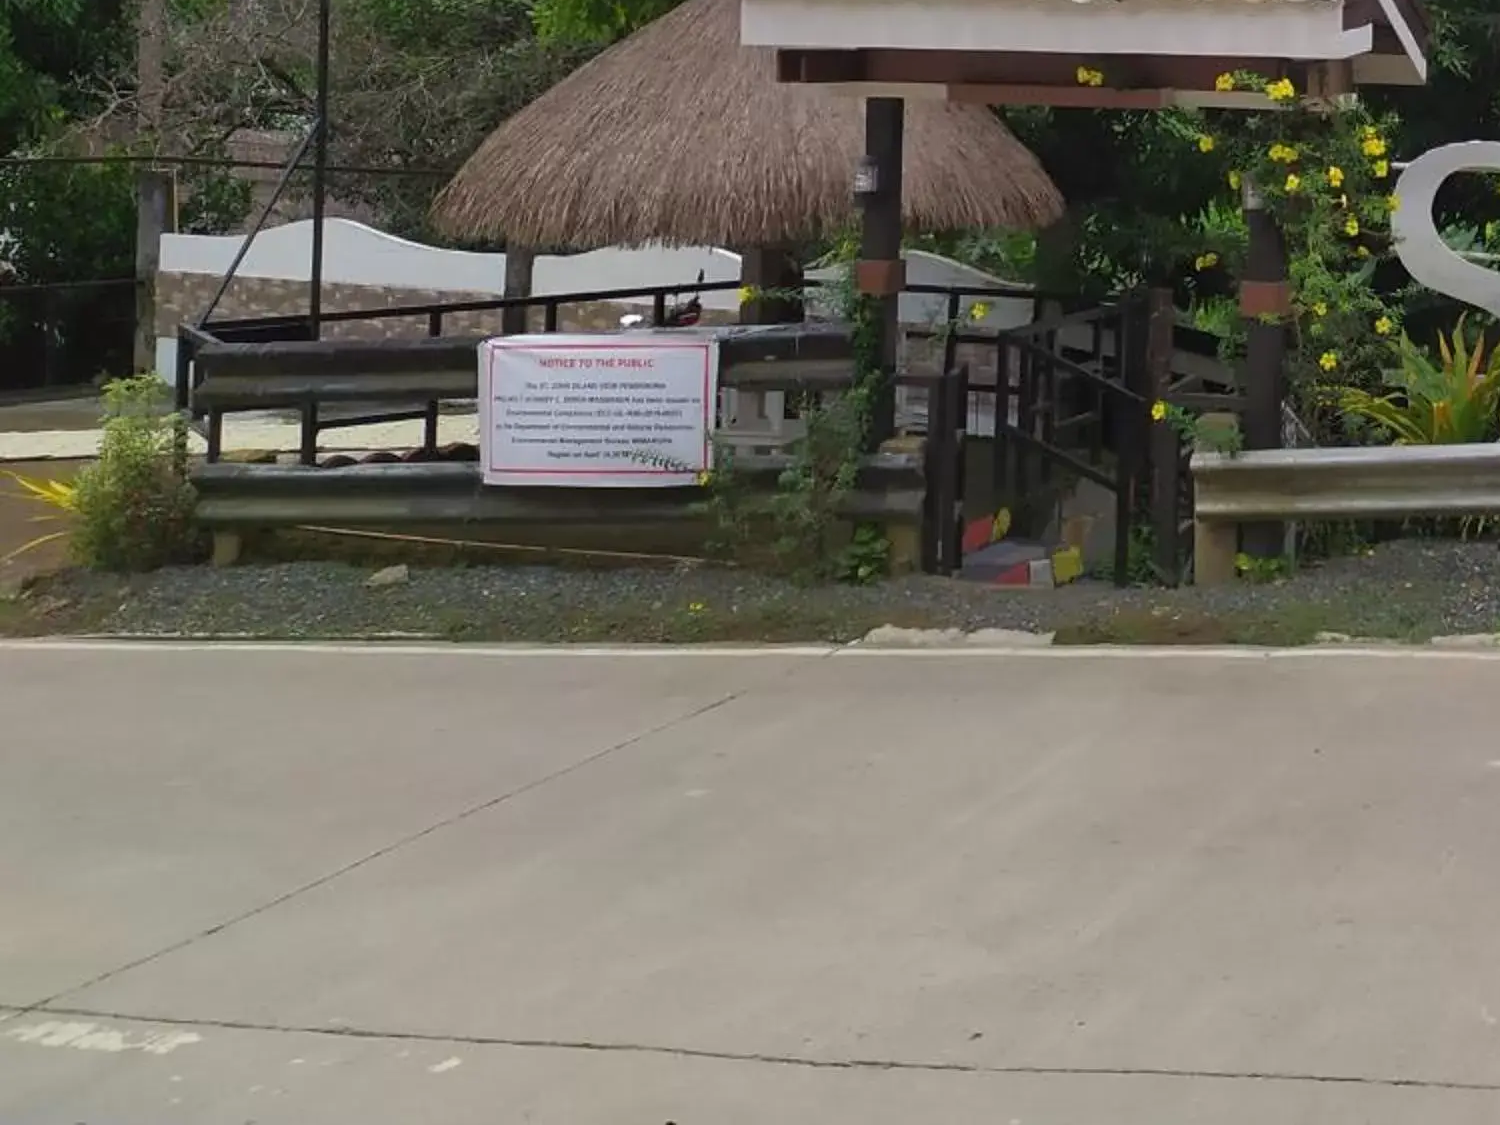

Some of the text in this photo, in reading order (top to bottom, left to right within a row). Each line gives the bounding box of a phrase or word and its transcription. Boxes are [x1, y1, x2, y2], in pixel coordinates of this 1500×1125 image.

[539, 358, 655, 368] NOTICE TO THE PUBLIC
